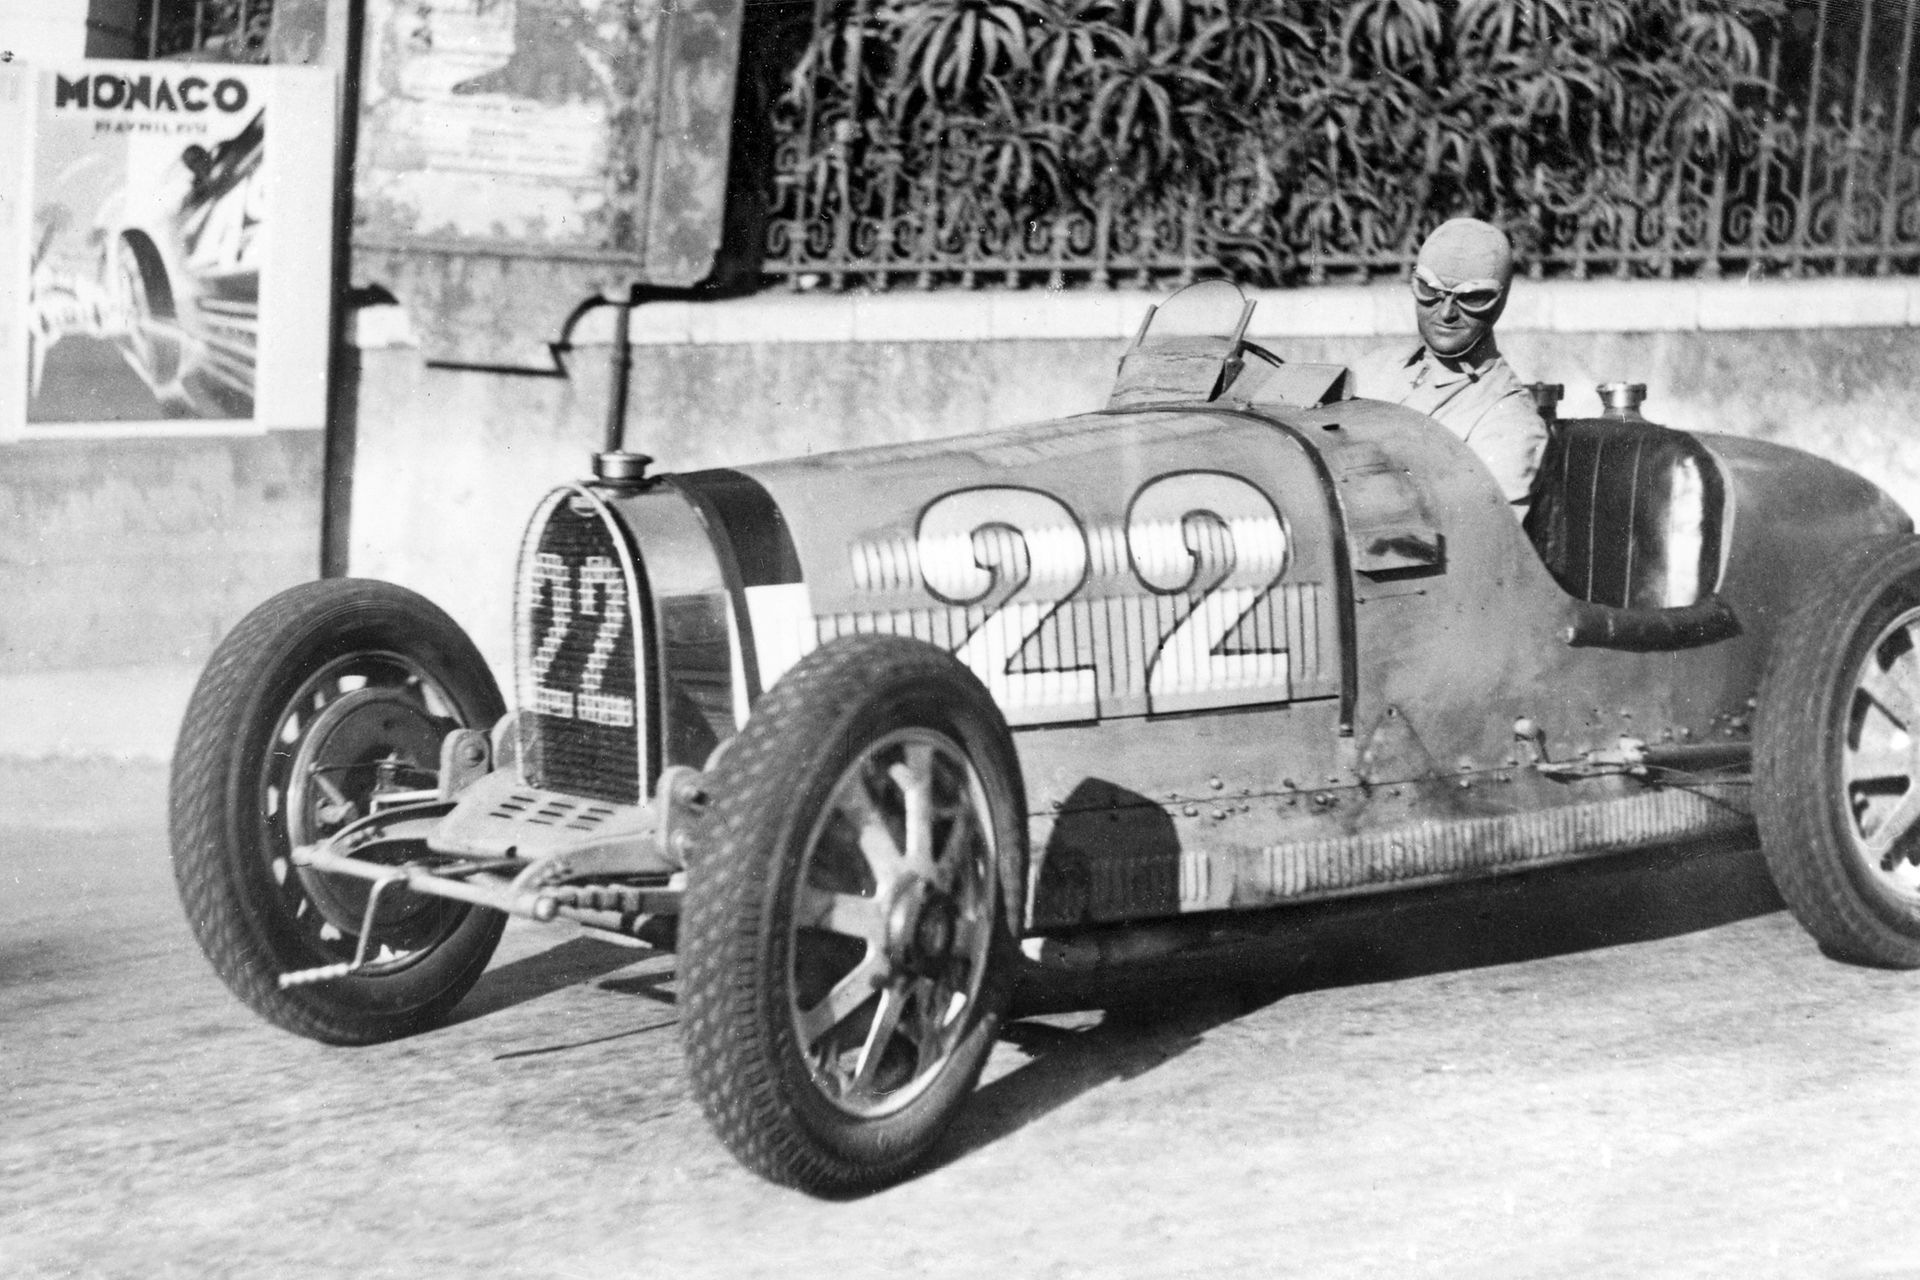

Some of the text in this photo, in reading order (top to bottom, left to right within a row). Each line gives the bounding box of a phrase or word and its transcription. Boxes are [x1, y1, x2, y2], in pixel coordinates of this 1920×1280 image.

[55, 74, 249, 113] MONACO
[528, 552, 634, 728] 22
[915, 469, 1291, 731] 22
